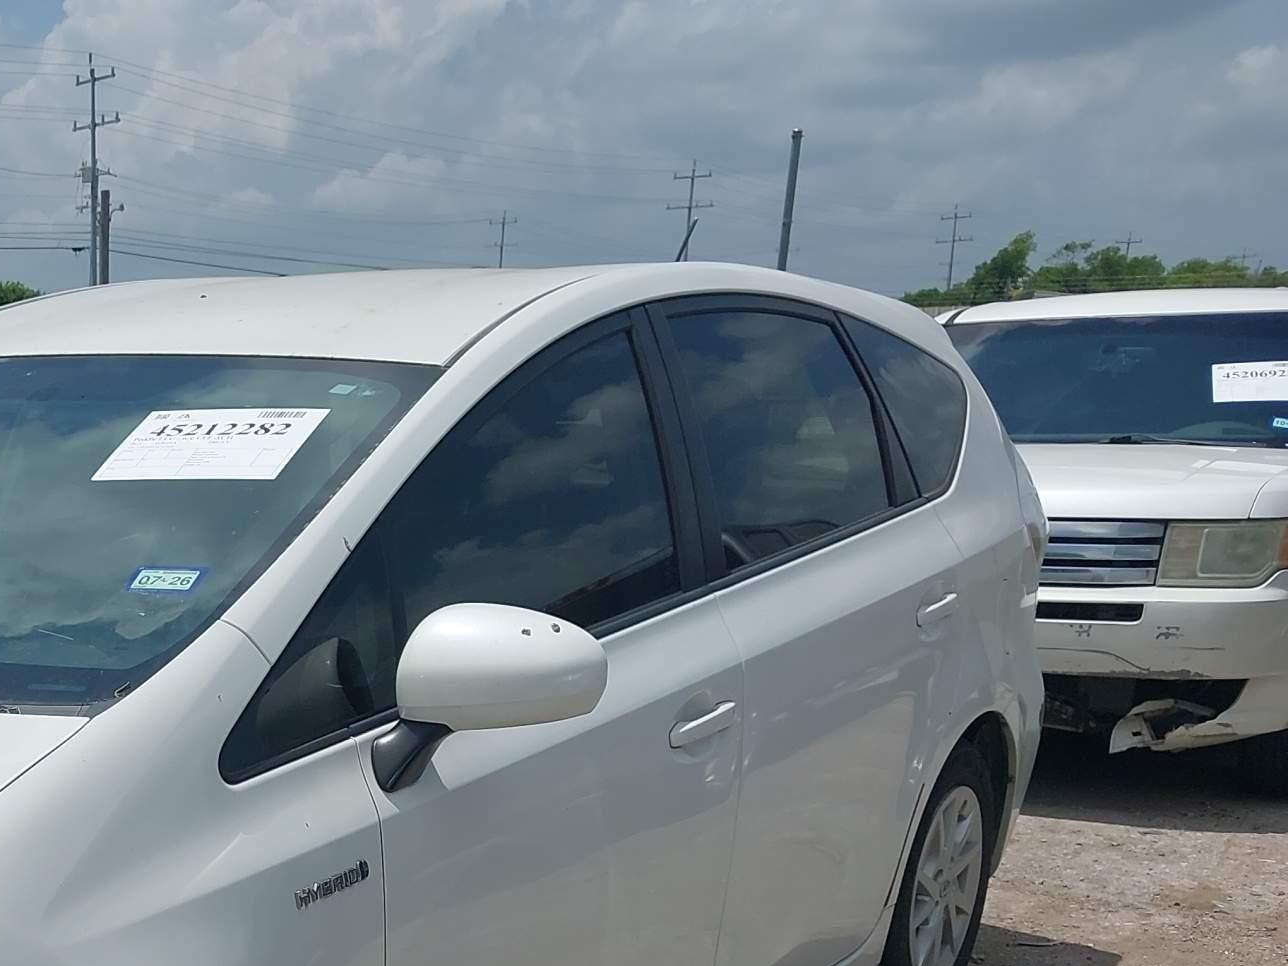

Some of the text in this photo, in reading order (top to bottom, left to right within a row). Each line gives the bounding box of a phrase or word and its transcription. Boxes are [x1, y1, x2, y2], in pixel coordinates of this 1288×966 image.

[1222, 369, 1288, 379] 4520692
[150, 422, 292, 437] 45212282
[295, 866, 359, 910] HYBRID
